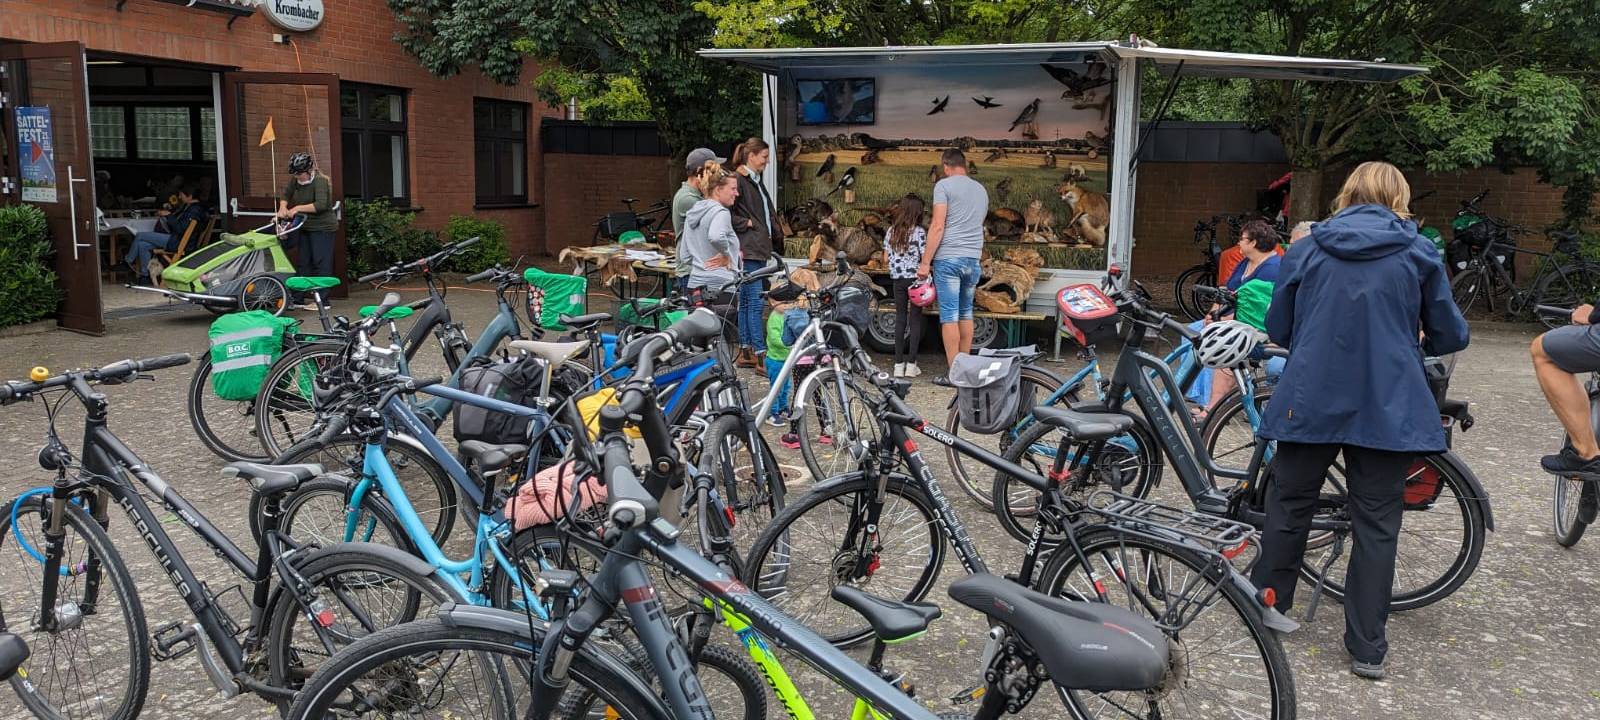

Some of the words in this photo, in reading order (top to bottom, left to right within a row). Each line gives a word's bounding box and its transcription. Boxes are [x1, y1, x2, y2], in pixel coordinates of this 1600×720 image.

[275, 0, 320, 21] Krombacher
[17, 115, 49, 129] SATTEL-
[18, 128, 42, 143] FEST
[923, 425, 954, 446] SOLERO
[120, 496, 191, 598] HERCULES
